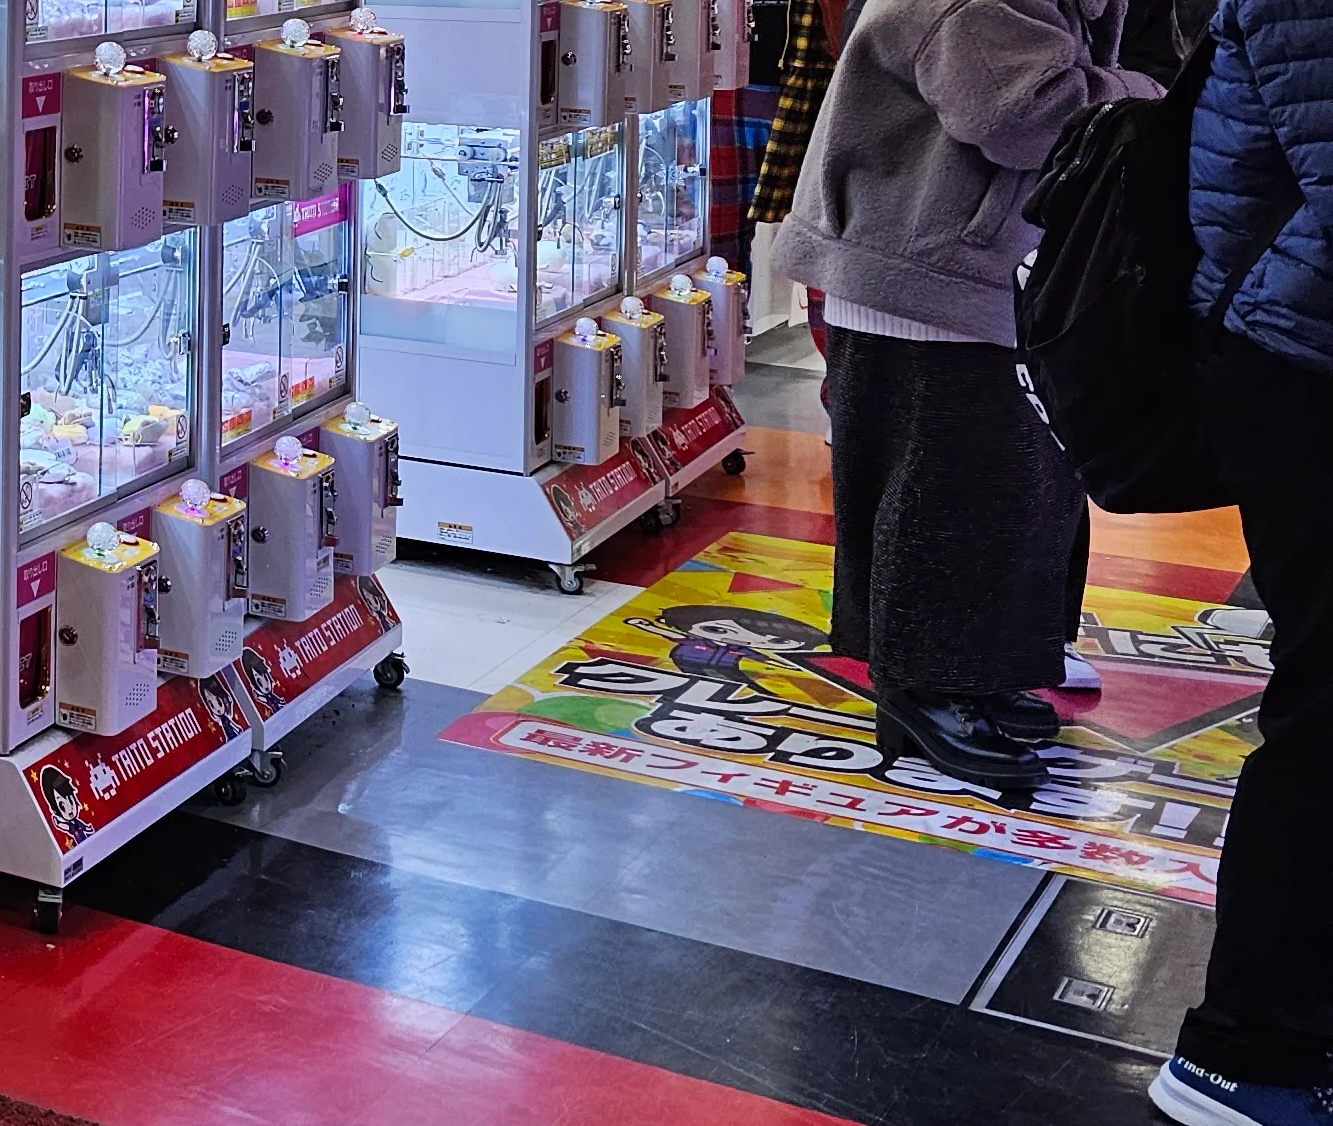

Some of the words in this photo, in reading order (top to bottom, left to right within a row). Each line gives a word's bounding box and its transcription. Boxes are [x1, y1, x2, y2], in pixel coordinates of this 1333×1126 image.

[589, 479, 609, 503] TAITO
[608, 461, 637, 495] STATION
[294, 630, 326, 664] TAITO
[324, 603, 365, 647] STATION
[111, 738, 153, 782] TAITO
[151, 706, 202, 760] STATION
[520, 727, 1218, 886] 最新フィギュアが多数入
